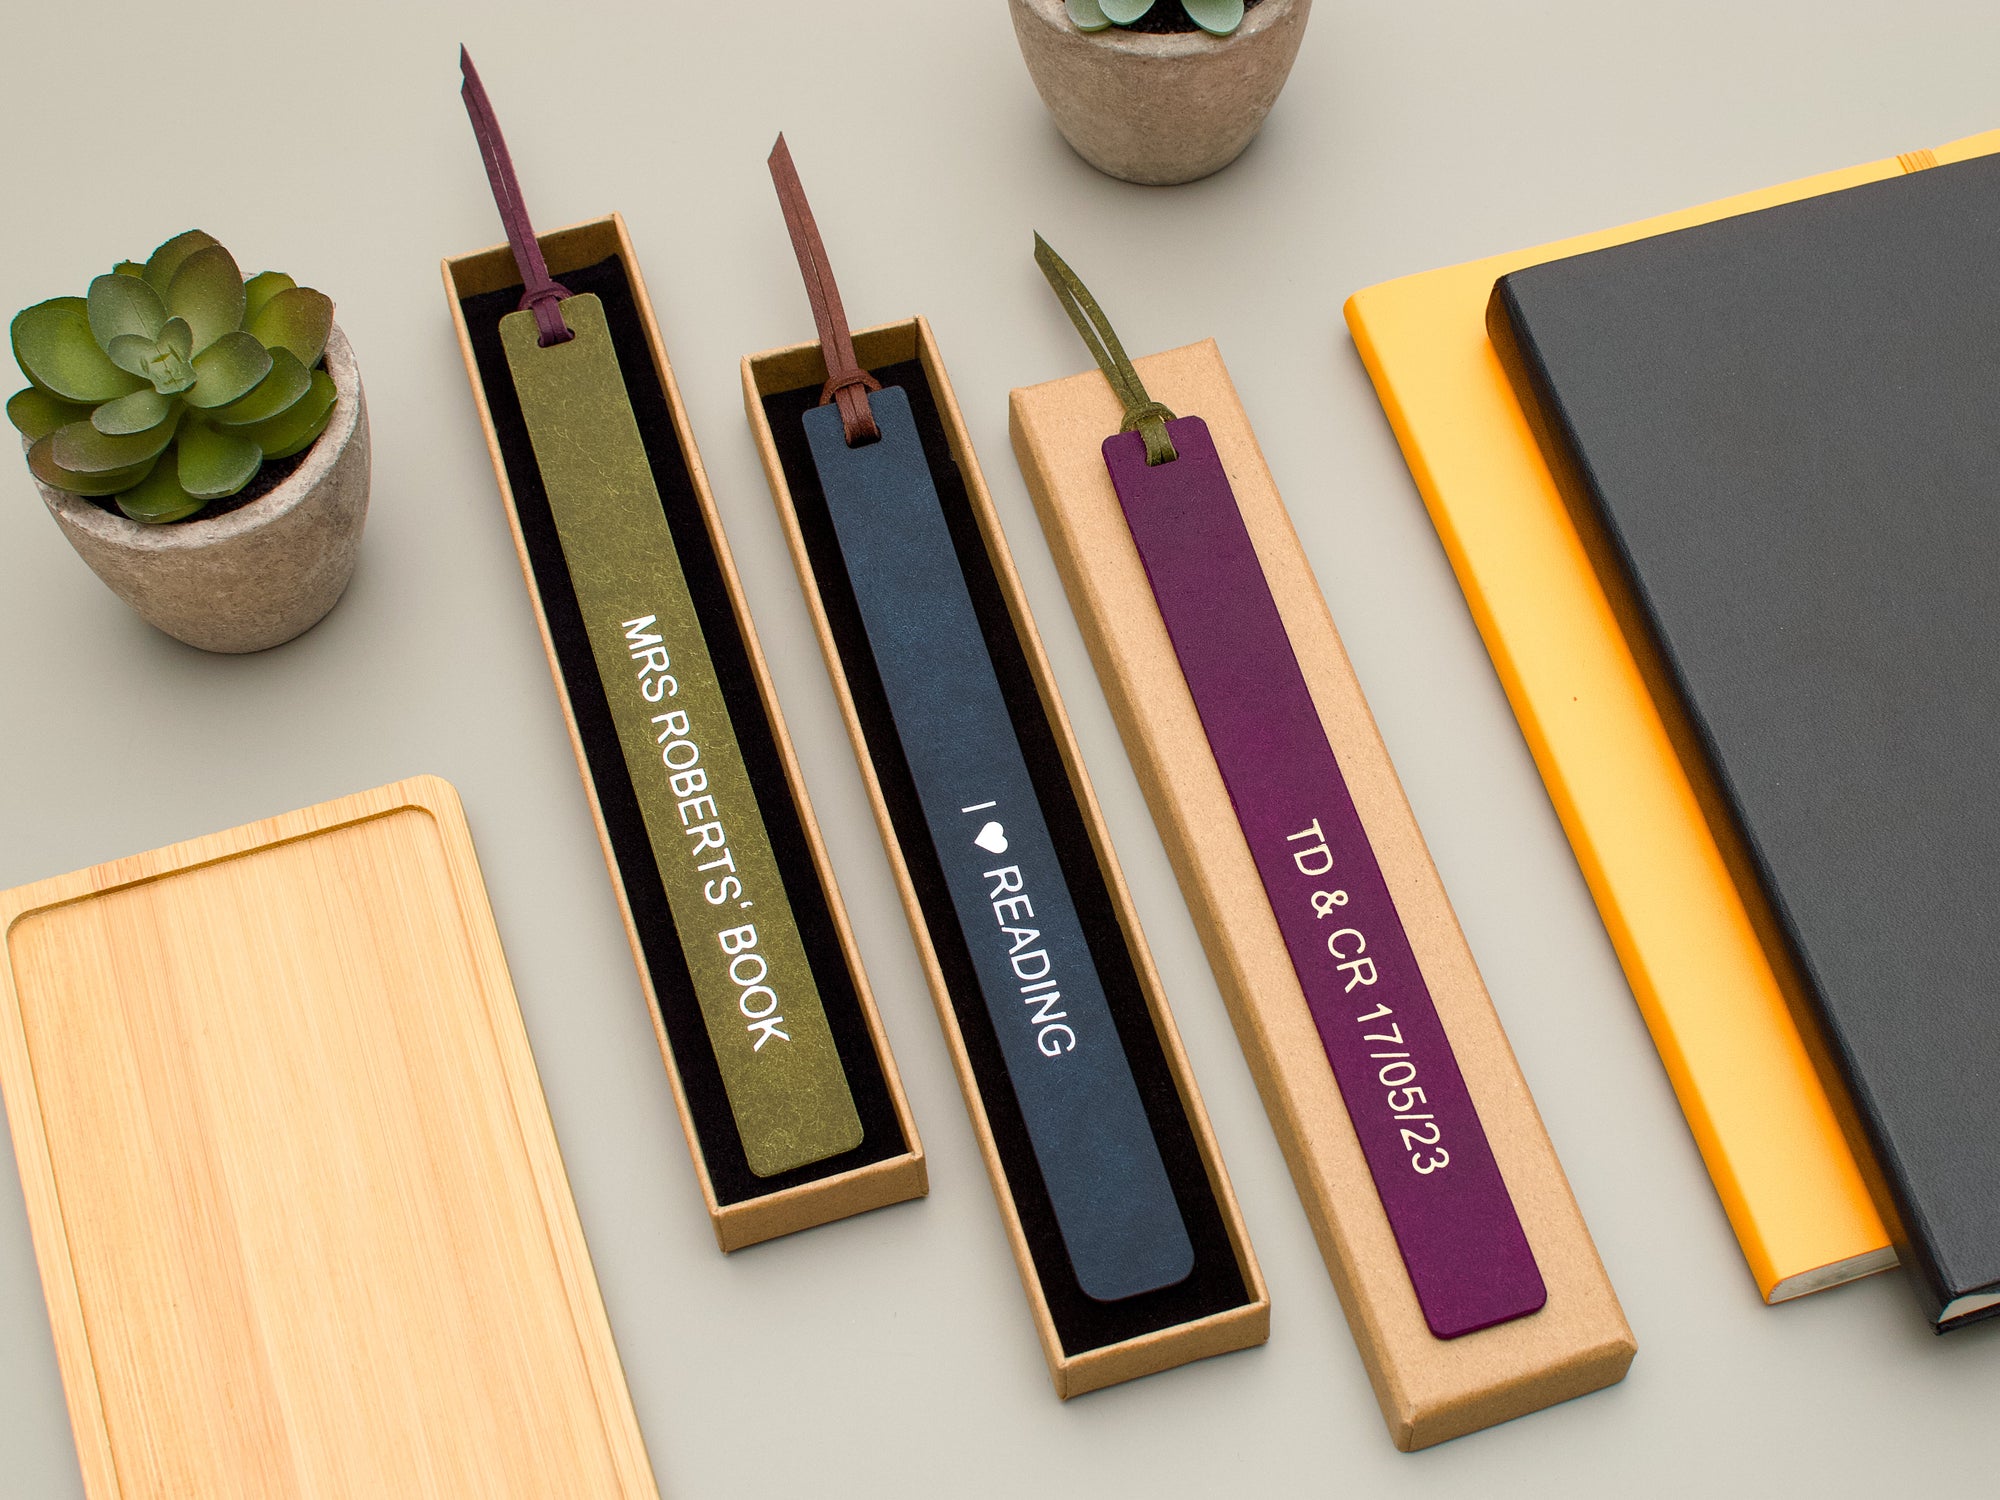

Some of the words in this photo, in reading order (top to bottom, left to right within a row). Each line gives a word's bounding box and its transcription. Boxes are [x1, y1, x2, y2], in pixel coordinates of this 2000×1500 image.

[621, 614, 679, 703] MRS
[717, 923, 791, 1053] BOOK
[1286, 816, 1334, 876] TD
[961, 800, 998, 813] I
[983, 864, 1077, 1057] READING
[1310, 889, 1349, 920] &
[1327, 928, 1379, 994] CR
[1356, 1003, 1451, 1176] 17/05/23
